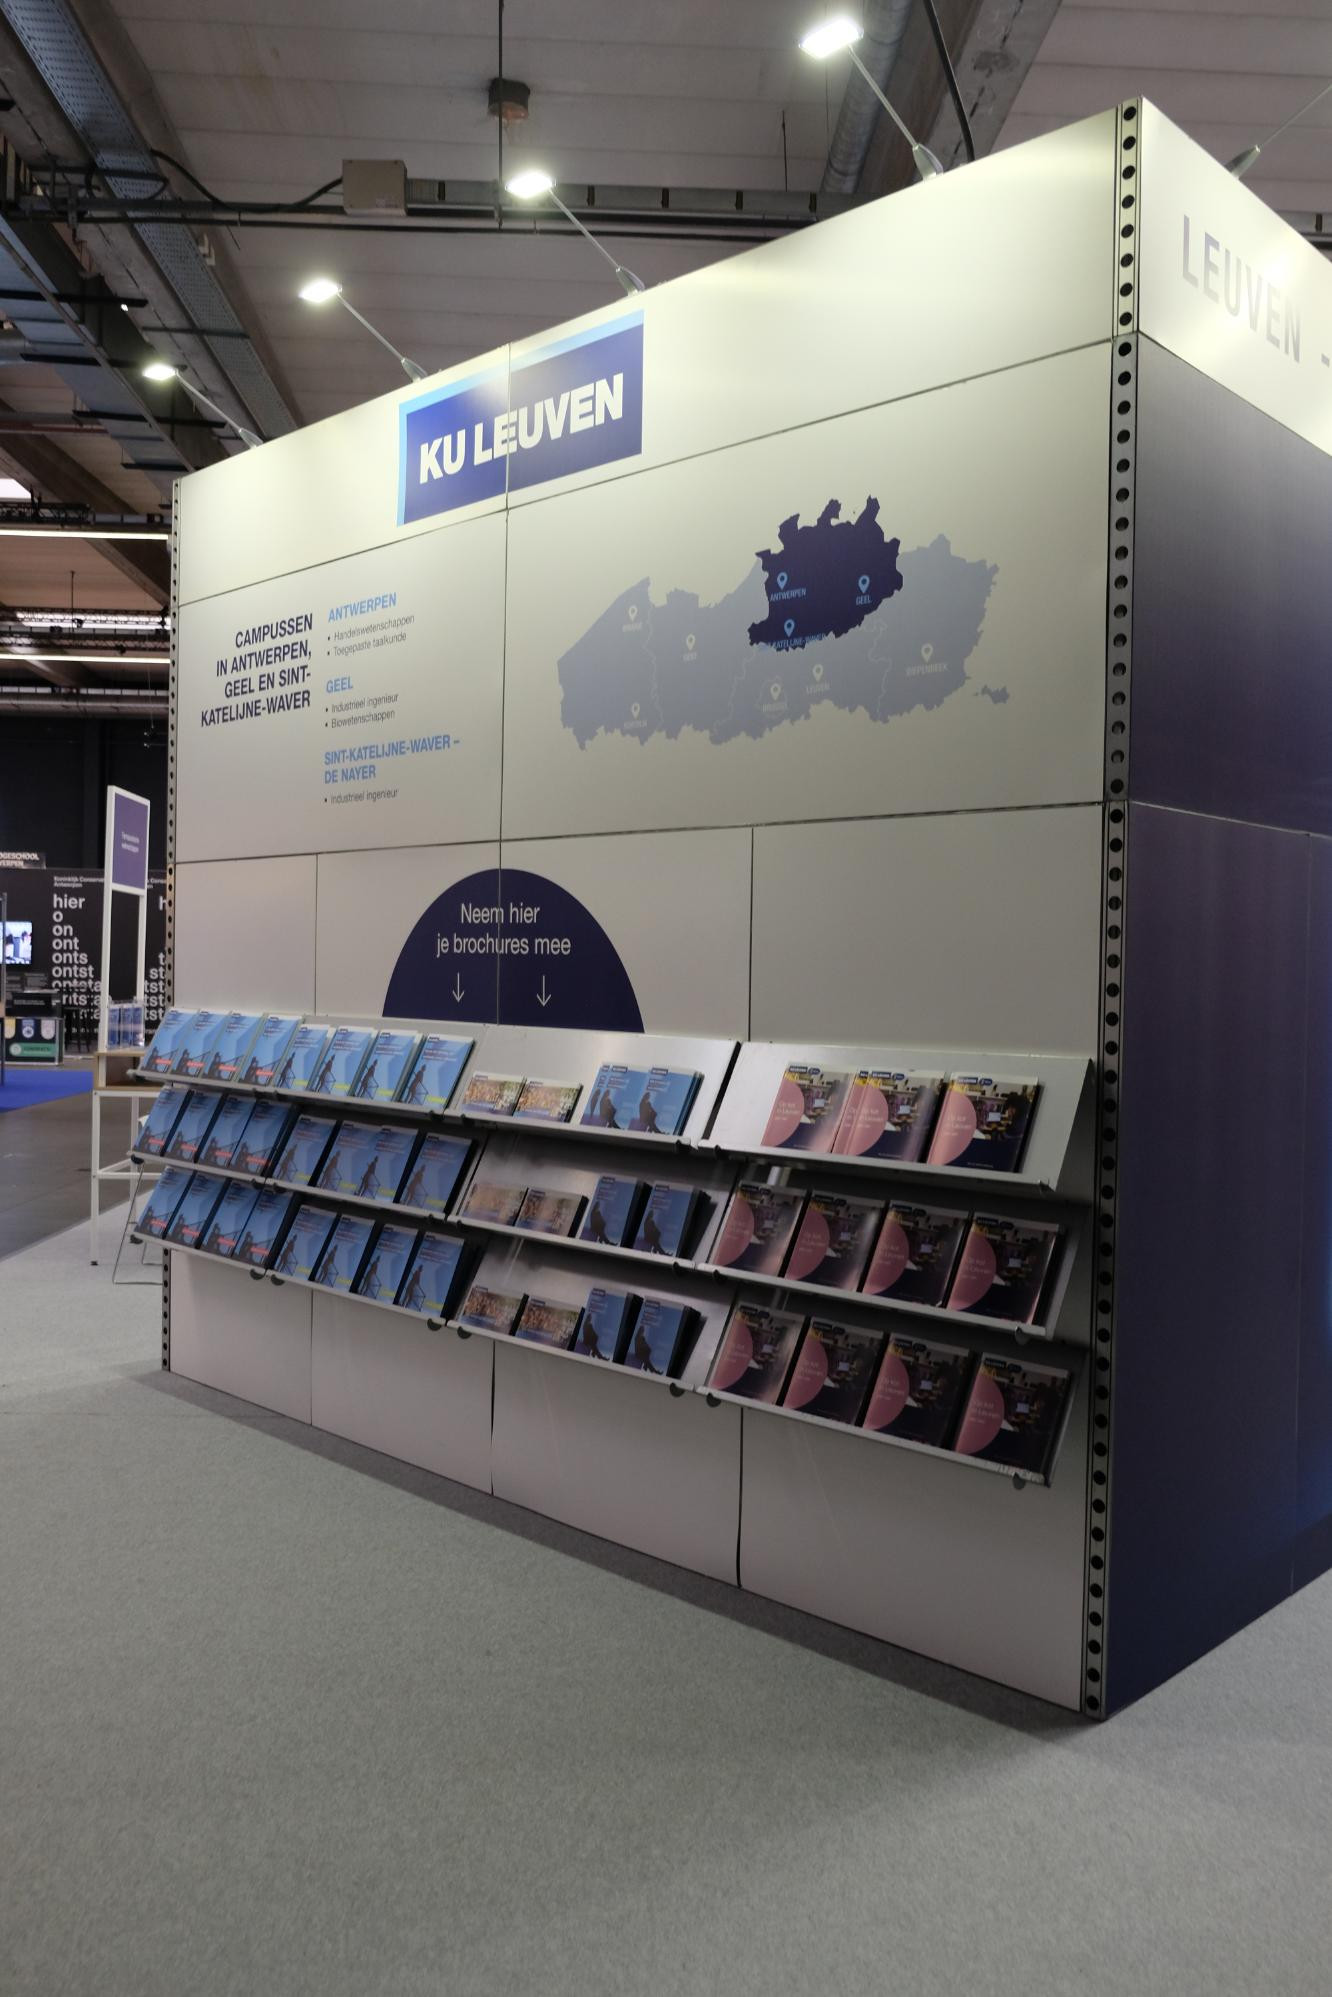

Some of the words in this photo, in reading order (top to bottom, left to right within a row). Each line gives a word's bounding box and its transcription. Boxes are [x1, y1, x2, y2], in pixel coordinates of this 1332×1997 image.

[1182, 214, 1300, 364] LEUVEN
[419, 428, 466, 485] KU
[473, 372, 624, 466] LEUVEN
[769, 588, 807, 602] ANTWERPEN
[855, 595, 873, 606] GEEL
[327, 591, 397, 623] ANTWERPEN
[235, 612, 313, 648] CAMPUSSEN
[333, 614, 415, 641] Handelswetenschappen
[333, 640, 372, 657] Toegepaste
[372, 631, 407, 649] taalkunde
[216, 658, 228, 677] IN
[230, 639, 312, 674] ANTWERPEN,
[224, 676, 255, 699] GEEL
[258, 671, 275, 692] EN
[278, 664, 311, 688] SINT-
[325, 676, 353, 694] GEEL
[200, 689, 311, 728] KATELIJNE-WAVER
[331, 698, 366, 714] Industrieel
[367, 693, 399, 709] ingenieur
[331, 709, 396, 729] Biowetenschappen
[324, 734, 451, 766] SINT-KATELIJNE-WAVER
[324, 769, 338, 785] DE
[341, 764, 377, 783] NAYER
[366, 788, 399, 802] ingenieur
[53, 893, 86, 909] hier
[52, 911, 64, 922] o
[460, 902, 504, 925] Neem
[509, 902, 540, 924] hier
[52, 924, 73, 937] on
[52, 937, 79, 951] ont
[436, 933, 449, 958] je
[453, 933, 529, 955] brochures
[534, 937, 572, 955] mee
[52, 951, 88, 965] onts
[52, 965, 94, 979] ontst
